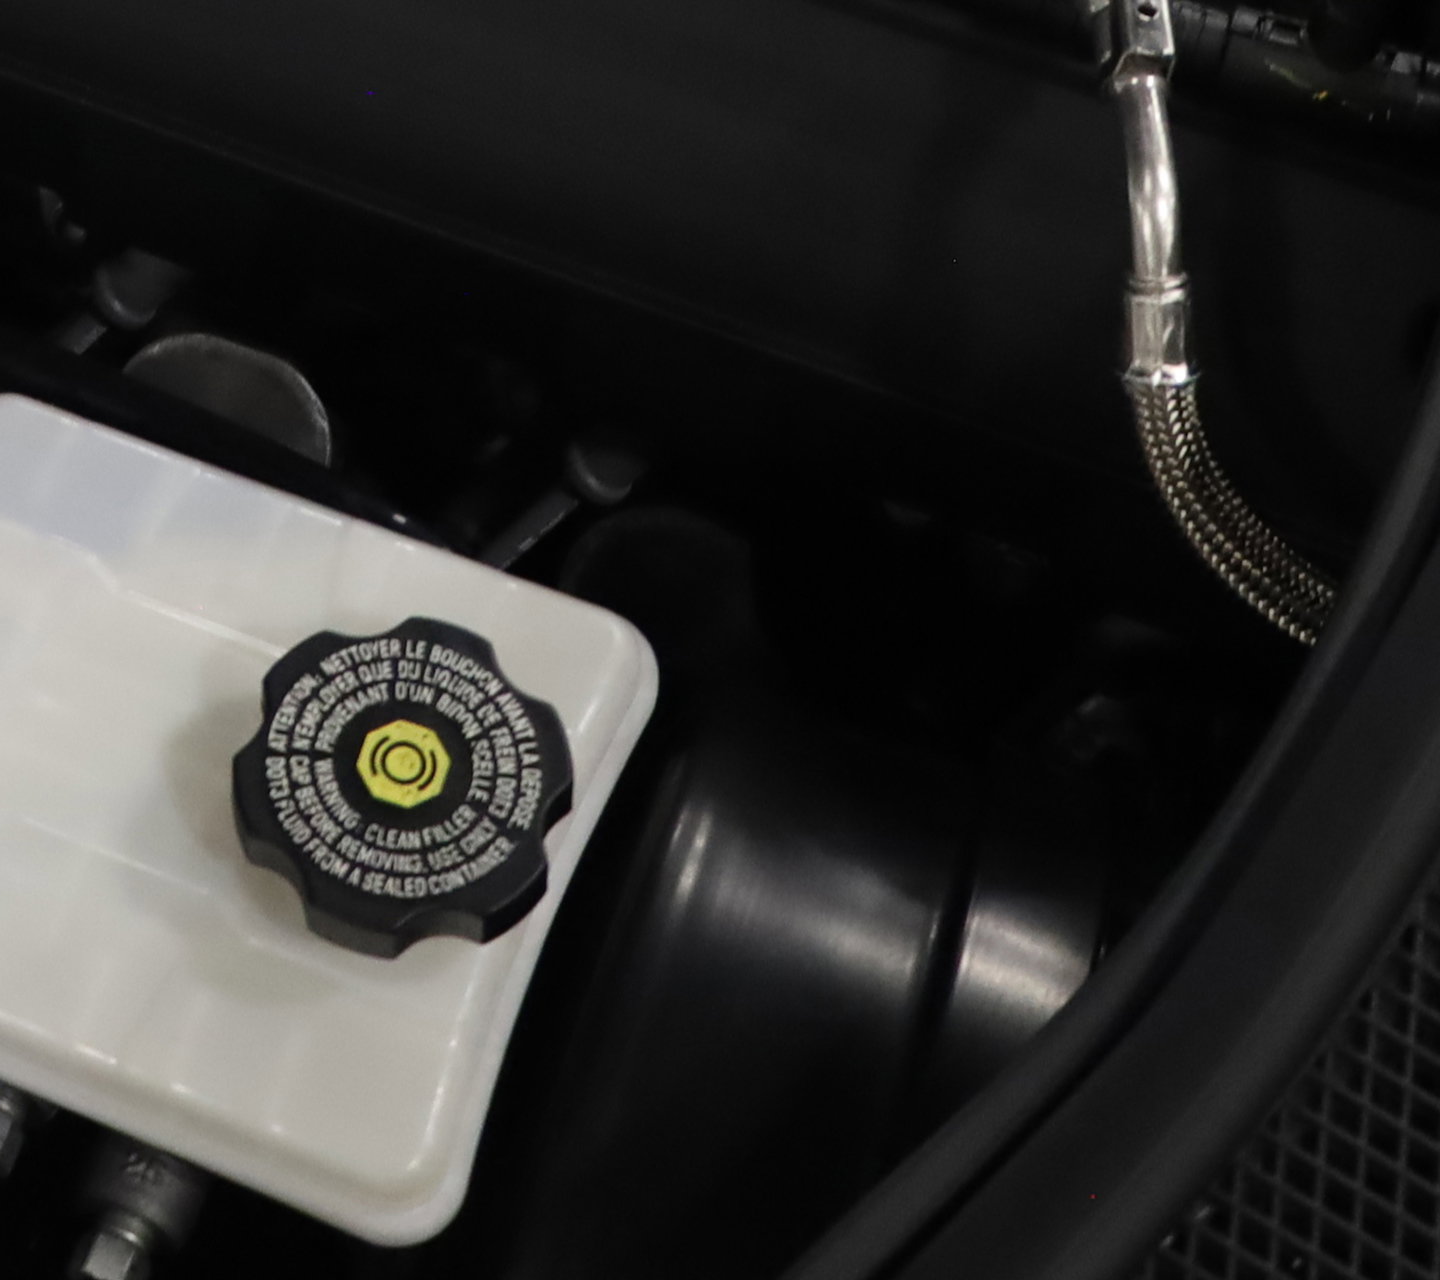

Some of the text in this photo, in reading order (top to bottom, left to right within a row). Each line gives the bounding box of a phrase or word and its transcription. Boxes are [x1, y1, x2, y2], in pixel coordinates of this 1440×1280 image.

[320, 639, 400, 676] NETTOYER
[406, 640, 427, 659] LE
[430, 644, 503, 696] BOUCHON
[495, 693, 535, 739] AVANT
[519, 743, 539, 765] LA
[358, 660, 393, 683] QUE
[398, 659, 420, 679] DU
[477, 703, 501, 727] DE
[490, 727, 517, 774] FREIN
[265, 756, 291, 799] DOT3
[274, 799, 312, 844] FLUID
[295, 786, 342, 845] BEFORE
[364, 823, 421, 850] CLEAN
[422, 804, 478, 845] FILLER
[303, 837, 350, 879] FROM
[346, 867, 361, 886] A
[361, 871, 427, 898] SEALED
